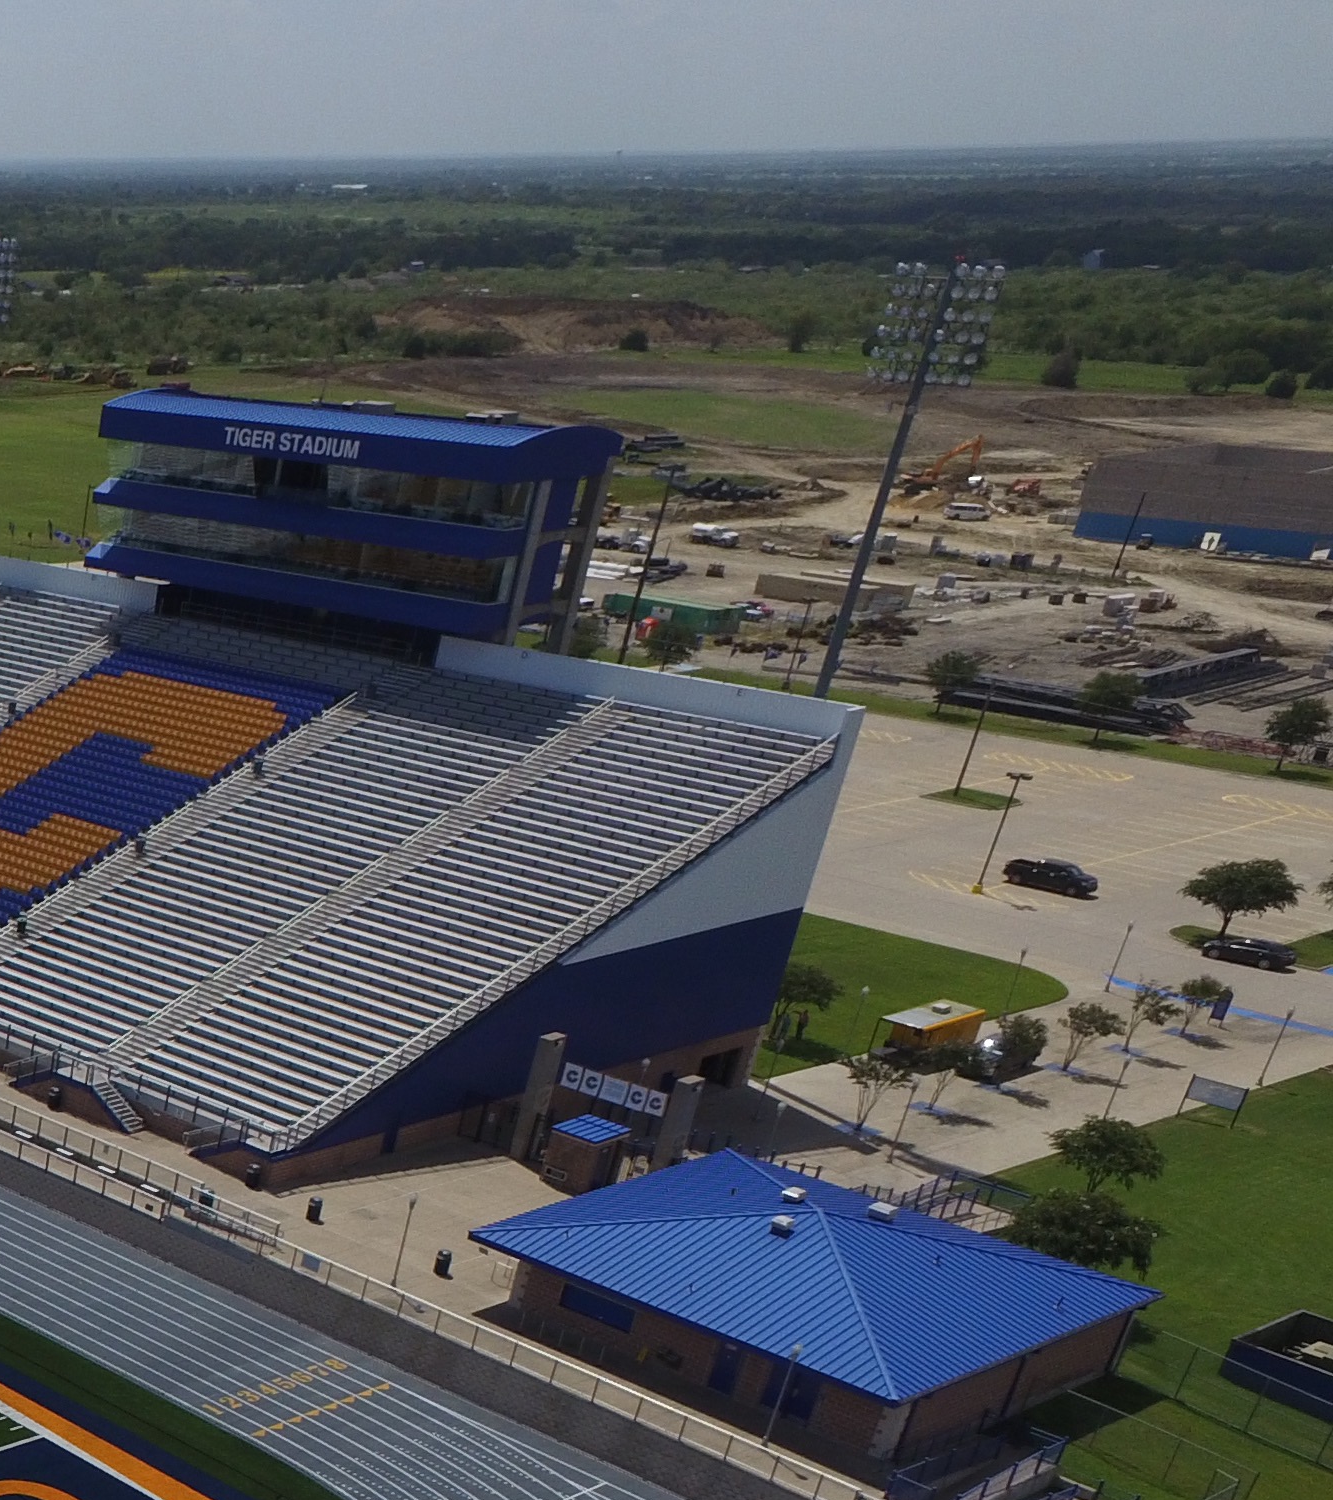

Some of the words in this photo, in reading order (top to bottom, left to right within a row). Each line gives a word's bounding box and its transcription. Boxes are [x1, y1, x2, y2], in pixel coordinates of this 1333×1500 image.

[224, 426, 276, 450] TIGER
[279, 432, 361, 460] STADIUM
[202, 1403, 224, 1415] 1
[219, 1396, 242, 1409] 2
[237, 1390, 261, 1402] 3
[259, 1383, 279, 1395] 4
[272, 1377, 296, 1389] 5
[290, 1371, 313, 1383] 6
[306, 1365, 329, 1376] 7
[324, 1359, 347, 1370] 8
